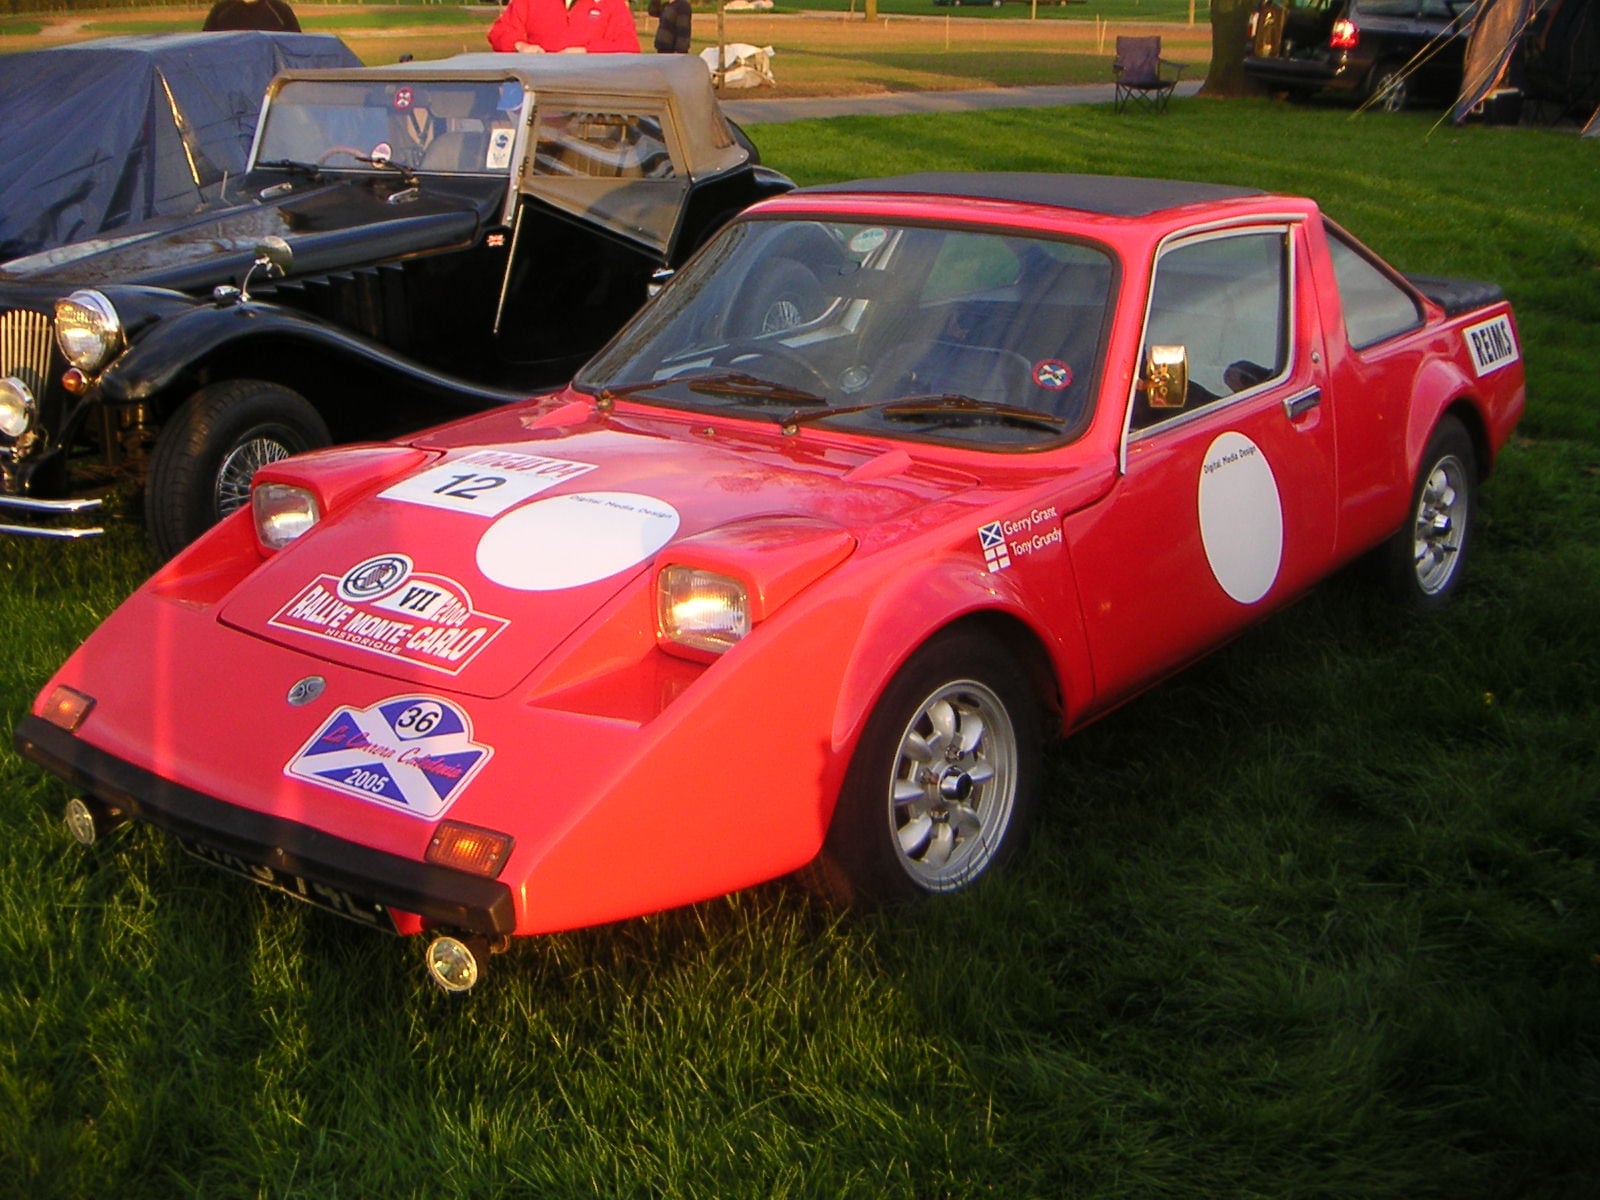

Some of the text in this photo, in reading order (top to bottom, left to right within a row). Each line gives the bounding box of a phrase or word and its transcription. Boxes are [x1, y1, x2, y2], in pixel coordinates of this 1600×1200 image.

[1471, 320, 1512, 366] REIMS
[1203, 446, 1256, 474] Digital Media Design
[433, 473, 507, 499] 12
[605, 501, 634, 511] Media
[638, 508, 672, 518] Design
[1003, 506, 1057, 535] Gerry Grant
[1010, 527, 1062, 556] Tony Grundy
[287, 585, 354, 627] RALLYE
[399, 586, 442, 612] VII
[325, 628, 402, 654] HISTORIQUE
[398, 706, 439, 733] 36
[344, 768, 390, 793] 2005
